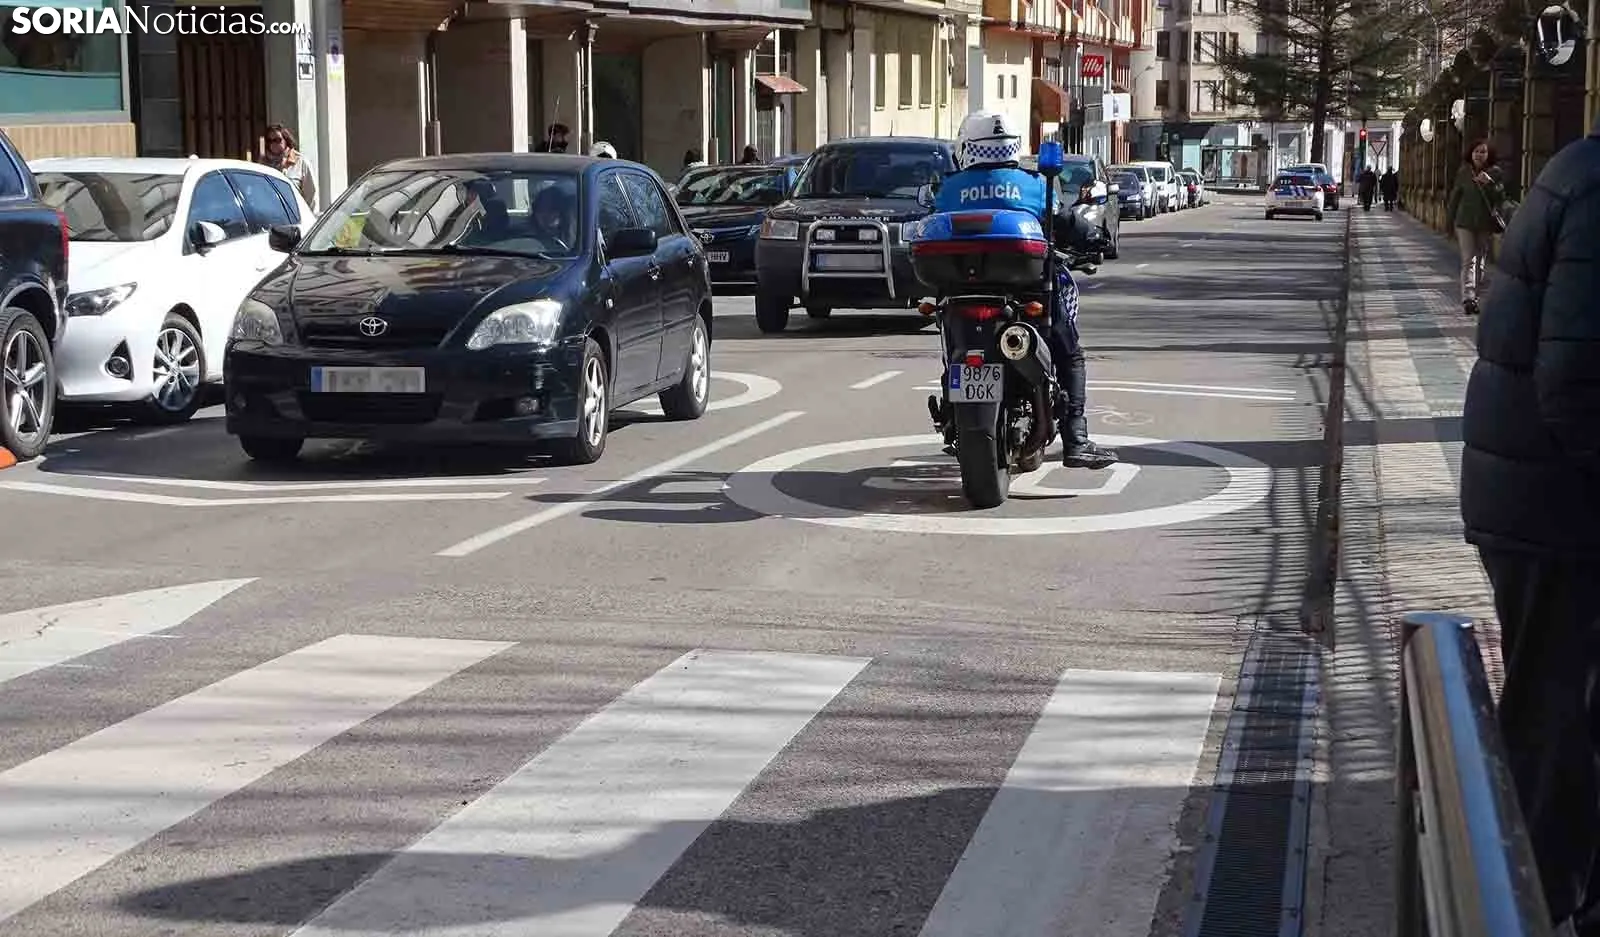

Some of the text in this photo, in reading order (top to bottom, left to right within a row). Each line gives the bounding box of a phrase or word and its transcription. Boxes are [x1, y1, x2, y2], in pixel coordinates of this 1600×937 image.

[1083, 58, 1103, 74] illy
[960, 181, 1022, 204] POLICÍA
[963, 366, 1001, 381] 9876
